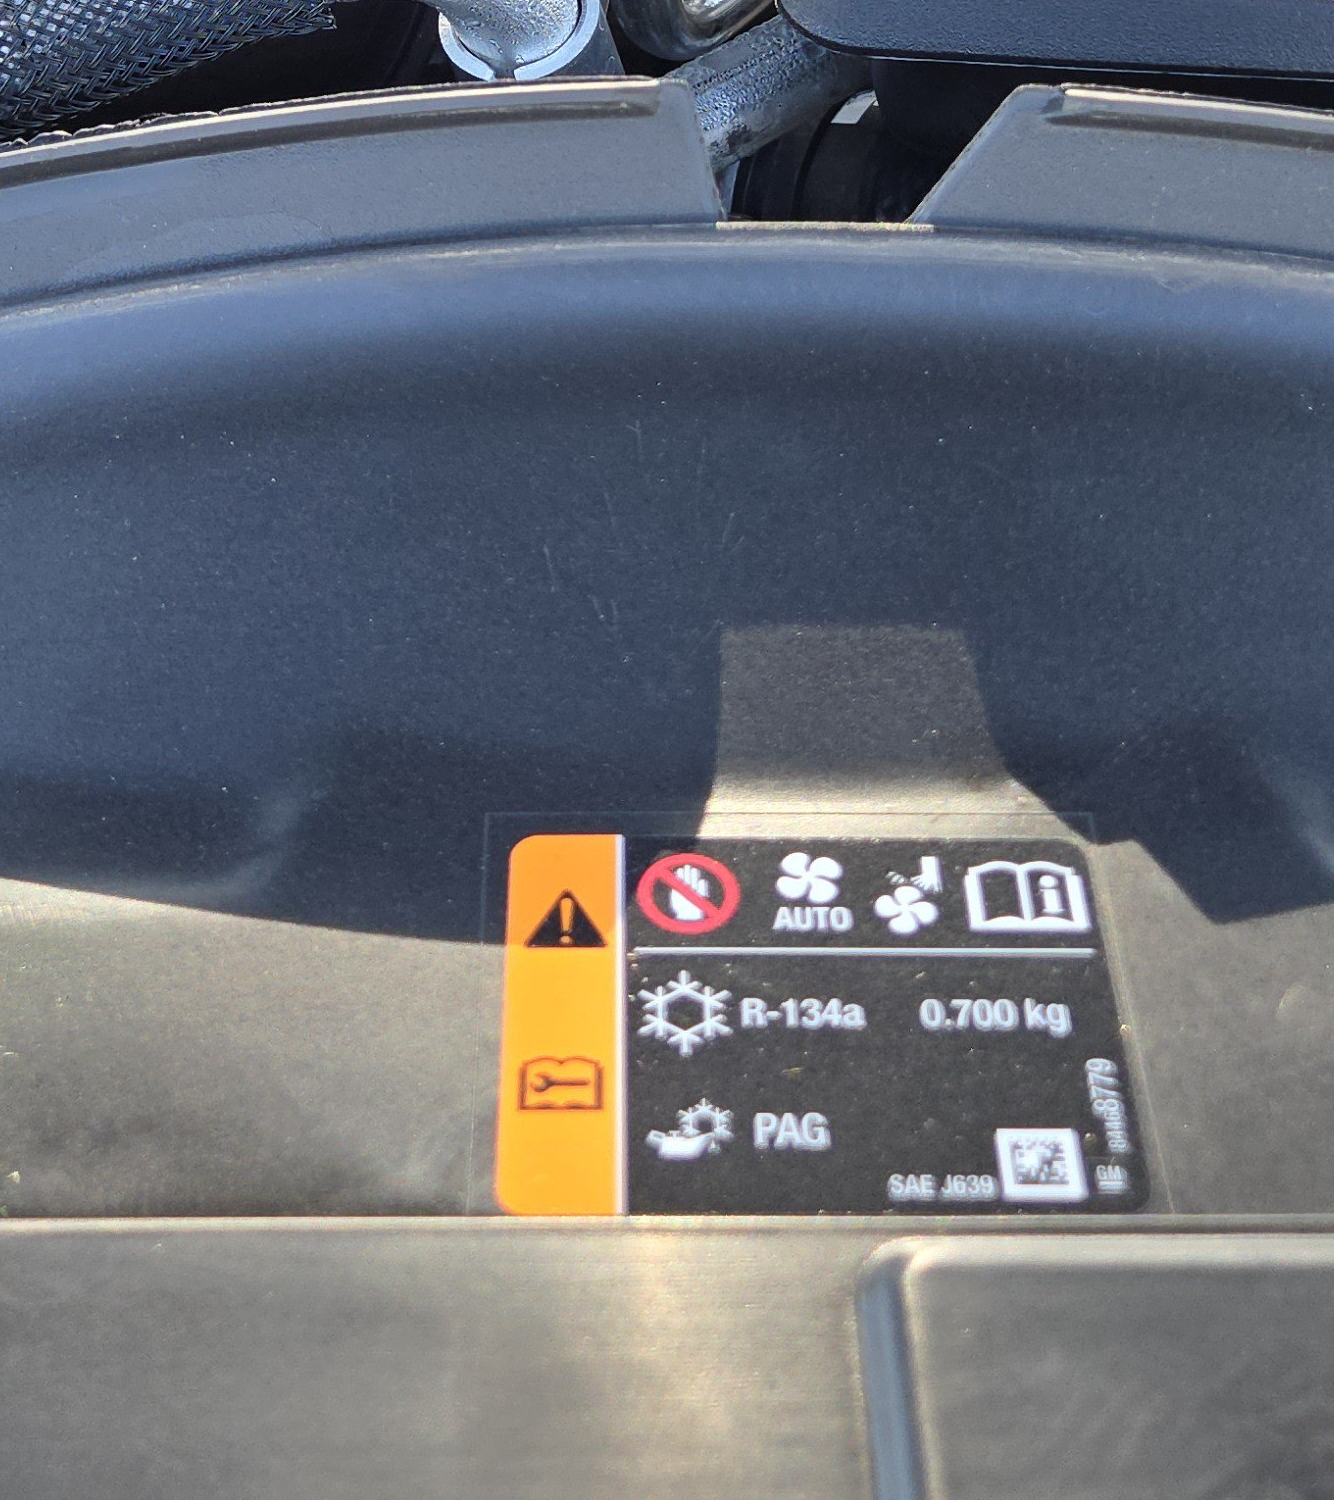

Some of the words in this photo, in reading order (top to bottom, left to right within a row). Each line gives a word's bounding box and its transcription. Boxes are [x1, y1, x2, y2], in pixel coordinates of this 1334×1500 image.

[772, 906, 854, 931] AUTO
[740, 997, 866, 1030] R-134a
[919, 998, 1018, 1031] 0.700
[1023, 997, 1073, 1038] kg
[753, 1112, 831, 1149] PAG
[887, 1173, 936, 1198] SAE
[940, 1174, 998, 1198] J639
[1095, 1164, 1128, 1183] GM
